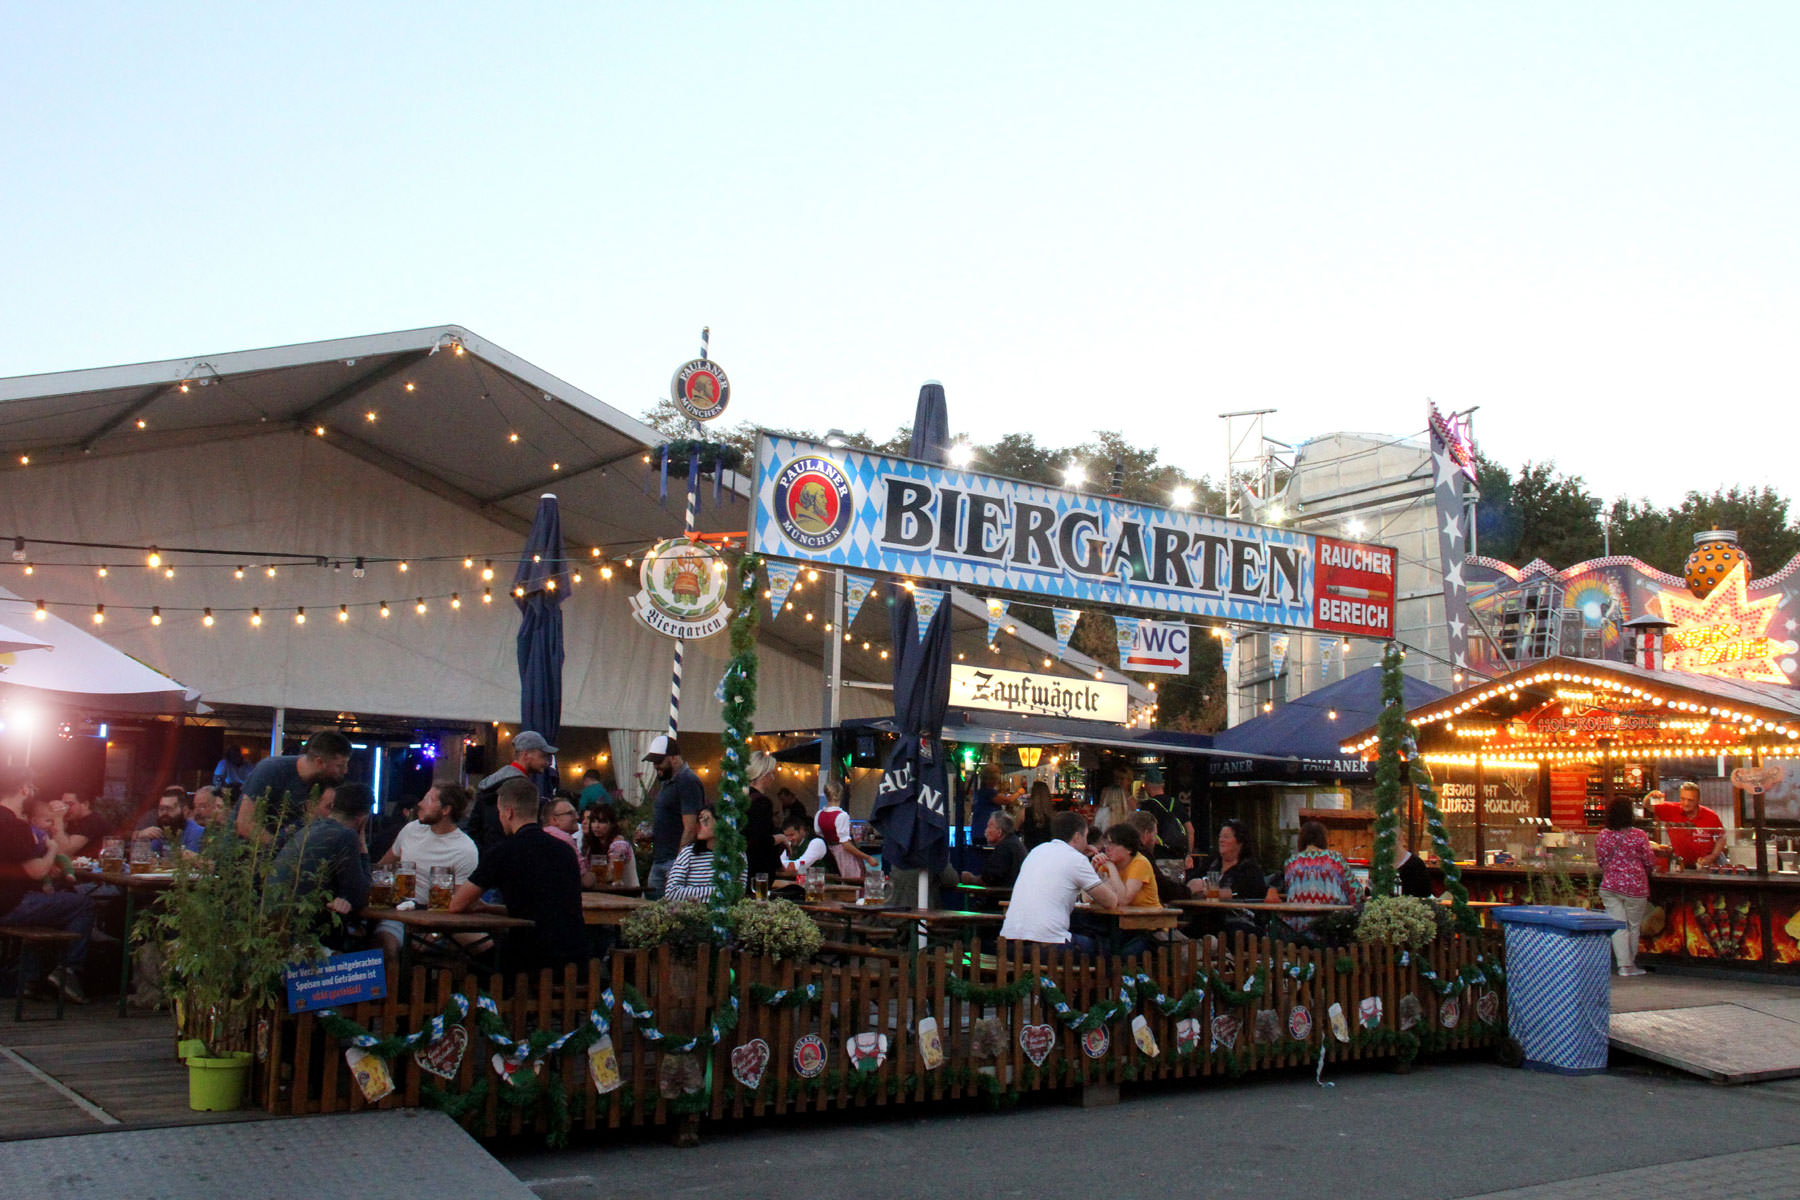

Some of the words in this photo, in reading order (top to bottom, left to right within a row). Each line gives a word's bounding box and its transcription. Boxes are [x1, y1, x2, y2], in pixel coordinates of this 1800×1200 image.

[680, 361, 728, 390] PAULANER
[780, 460, 848, 497] PAULANER
[882, 475, 1304, 605] BIERGARTEN
[1321, 544, 1391, 575] RAUCHER
[646, 608, 721, 640] Biergarten
[1320, 598, 1388, 628] BEREICH
[1141, 626, 1187, 654] WC
[972, 670, 1100, 712] Zapfwägele
[1303, 758, 1369, 773] PAULANER
